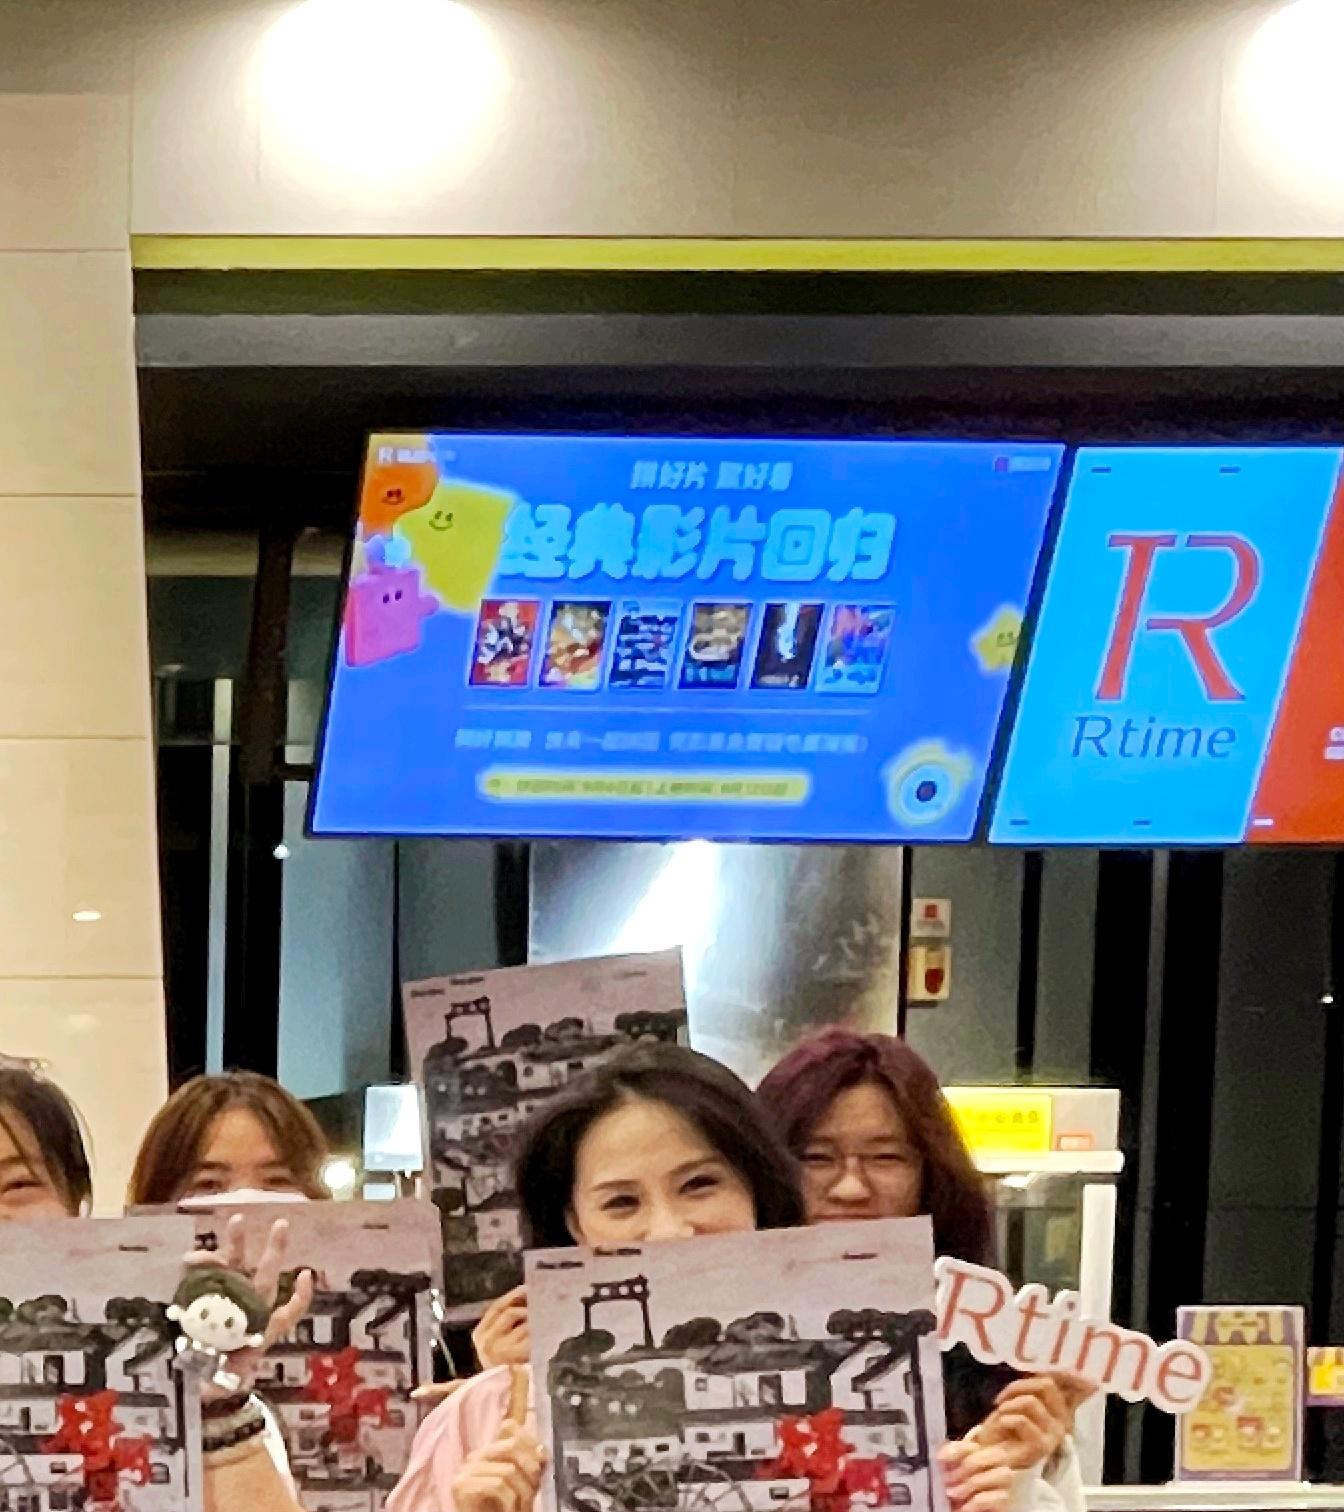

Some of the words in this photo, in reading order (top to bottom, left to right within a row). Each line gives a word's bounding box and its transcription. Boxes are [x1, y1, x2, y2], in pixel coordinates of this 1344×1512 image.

[502, 502, 897, 583] 经典影片回归
[1094, 532, 1261, 702] R
[1071, 714, 1237, 759] Rtime
[937, 1268, 1203, 1404] Rtime
